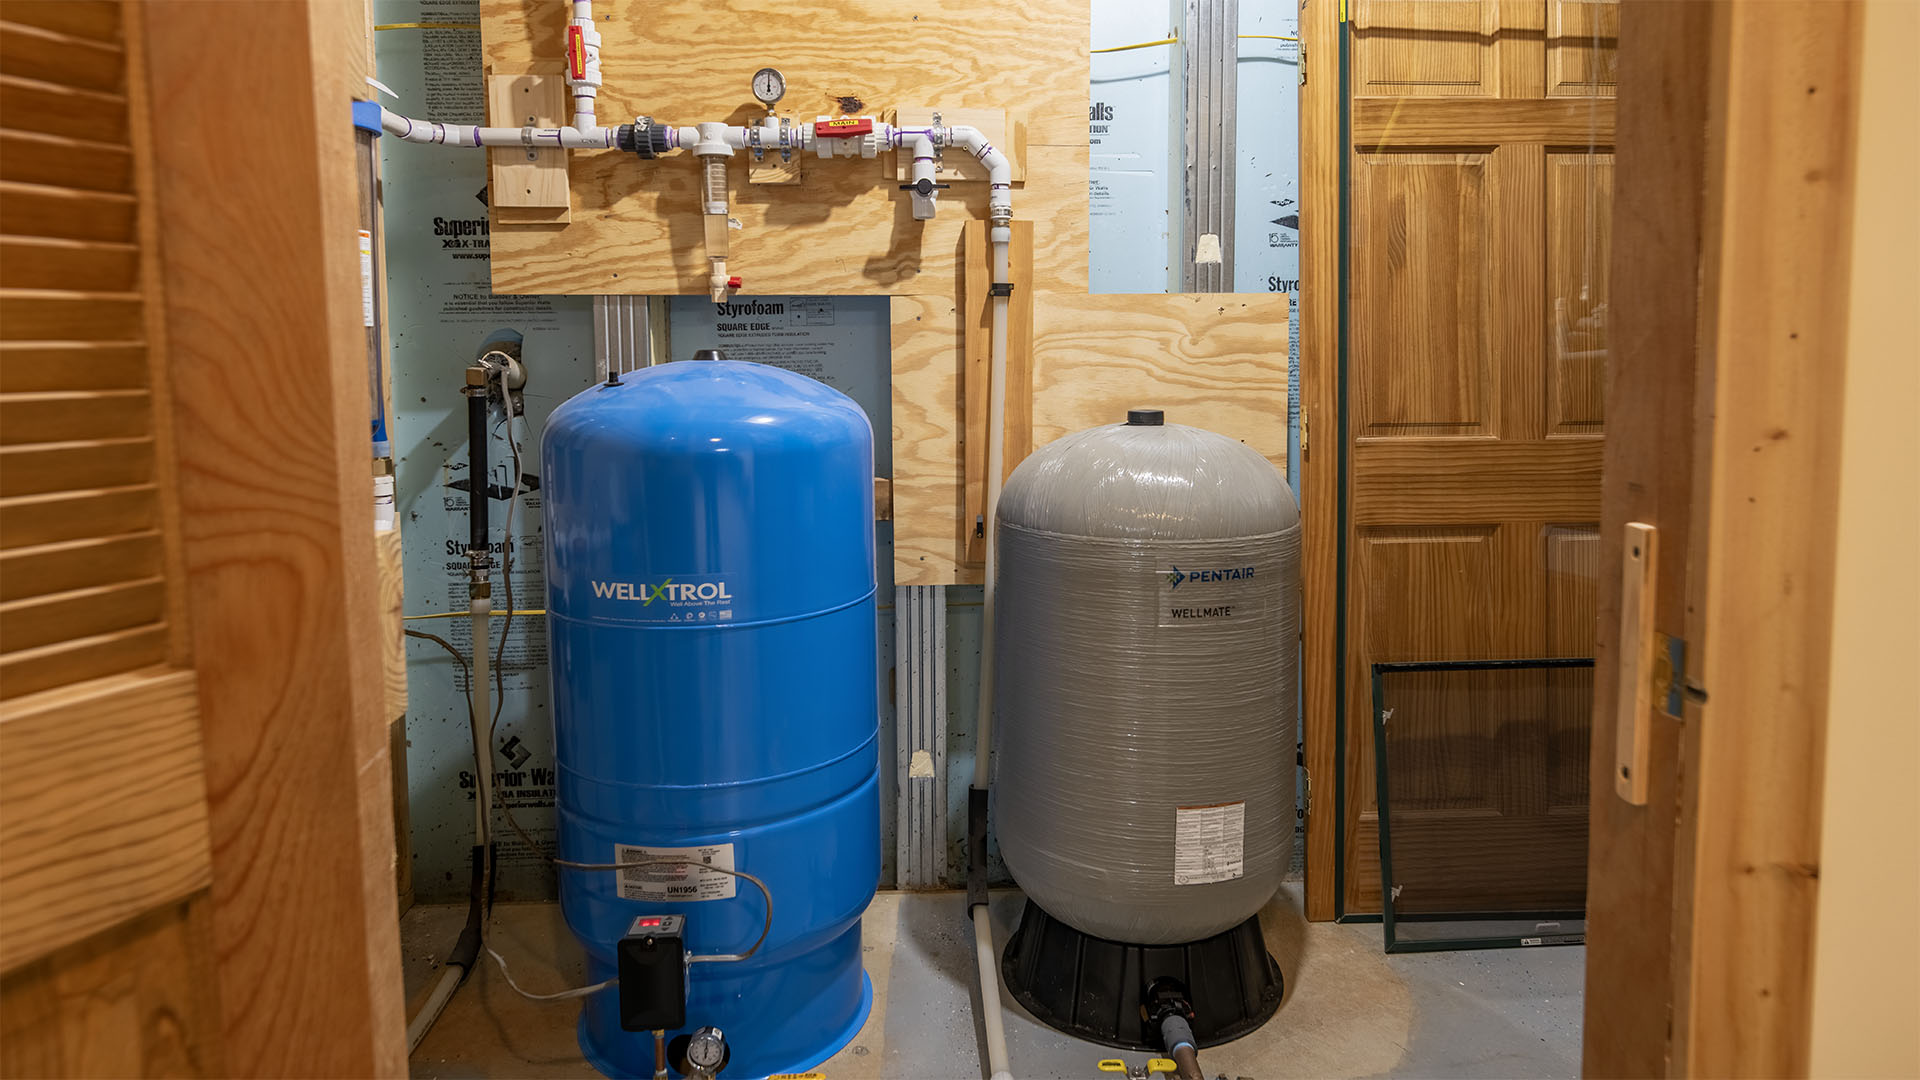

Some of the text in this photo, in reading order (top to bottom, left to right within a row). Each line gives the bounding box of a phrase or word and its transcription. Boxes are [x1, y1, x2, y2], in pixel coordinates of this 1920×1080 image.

[716, 299, 784, 318] Styrofoam
[717, 322, 748, 332] SQUARE
[750, 322, 770, 331] EDGE
[1189, 567, 1255, 582] PENTAIR
[591, 578, 732, 607] WELLXTROL
[667, 885, 698, 894] UN1956
